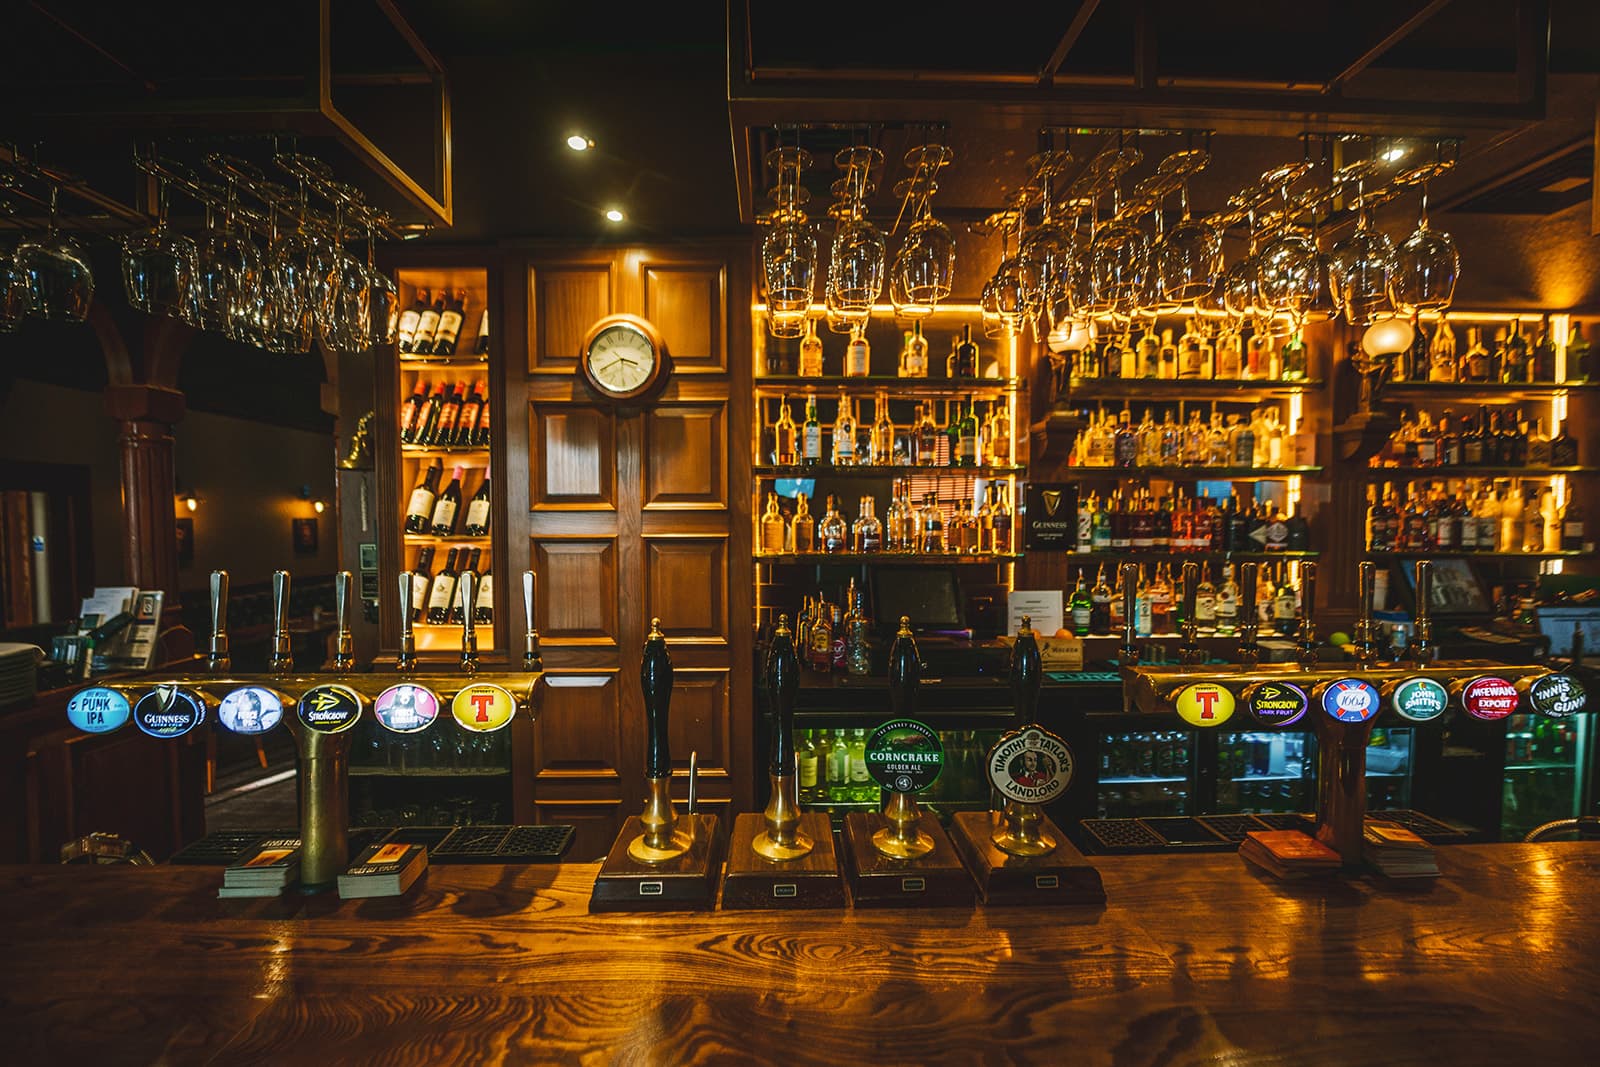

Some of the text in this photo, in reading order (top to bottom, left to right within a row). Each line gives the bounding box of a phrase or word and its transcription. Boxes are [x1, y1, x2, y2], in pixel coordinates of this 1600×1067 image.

[1032, 521, 1067, 529] GUINNESS
[1410, 690, 1436, 700] JOHN
[1536, 683, 1570, 700] INNIS
[81, 697, 111, 711] PUNK
[471, 694, 494, 722] T
[1195, 691, 1219, 719] T
[1256, 699, 1299, 710] STRONGBOW
[1479, 699, 1511, 708] EXPORT
[1553, 695, 1586, 712] GUNN
[87, 711, 104, 725] IPA
[144, 713, 190, 724] GUINNESS
[308, 710, 348, 722] STRONGBOW
[870, 752, 940, 762] CORNCRAKE
[995, 738, 1071, 774] TIMOTHY TAYLOR'S
[1006, 780, 1060, 797] LANDLORD
